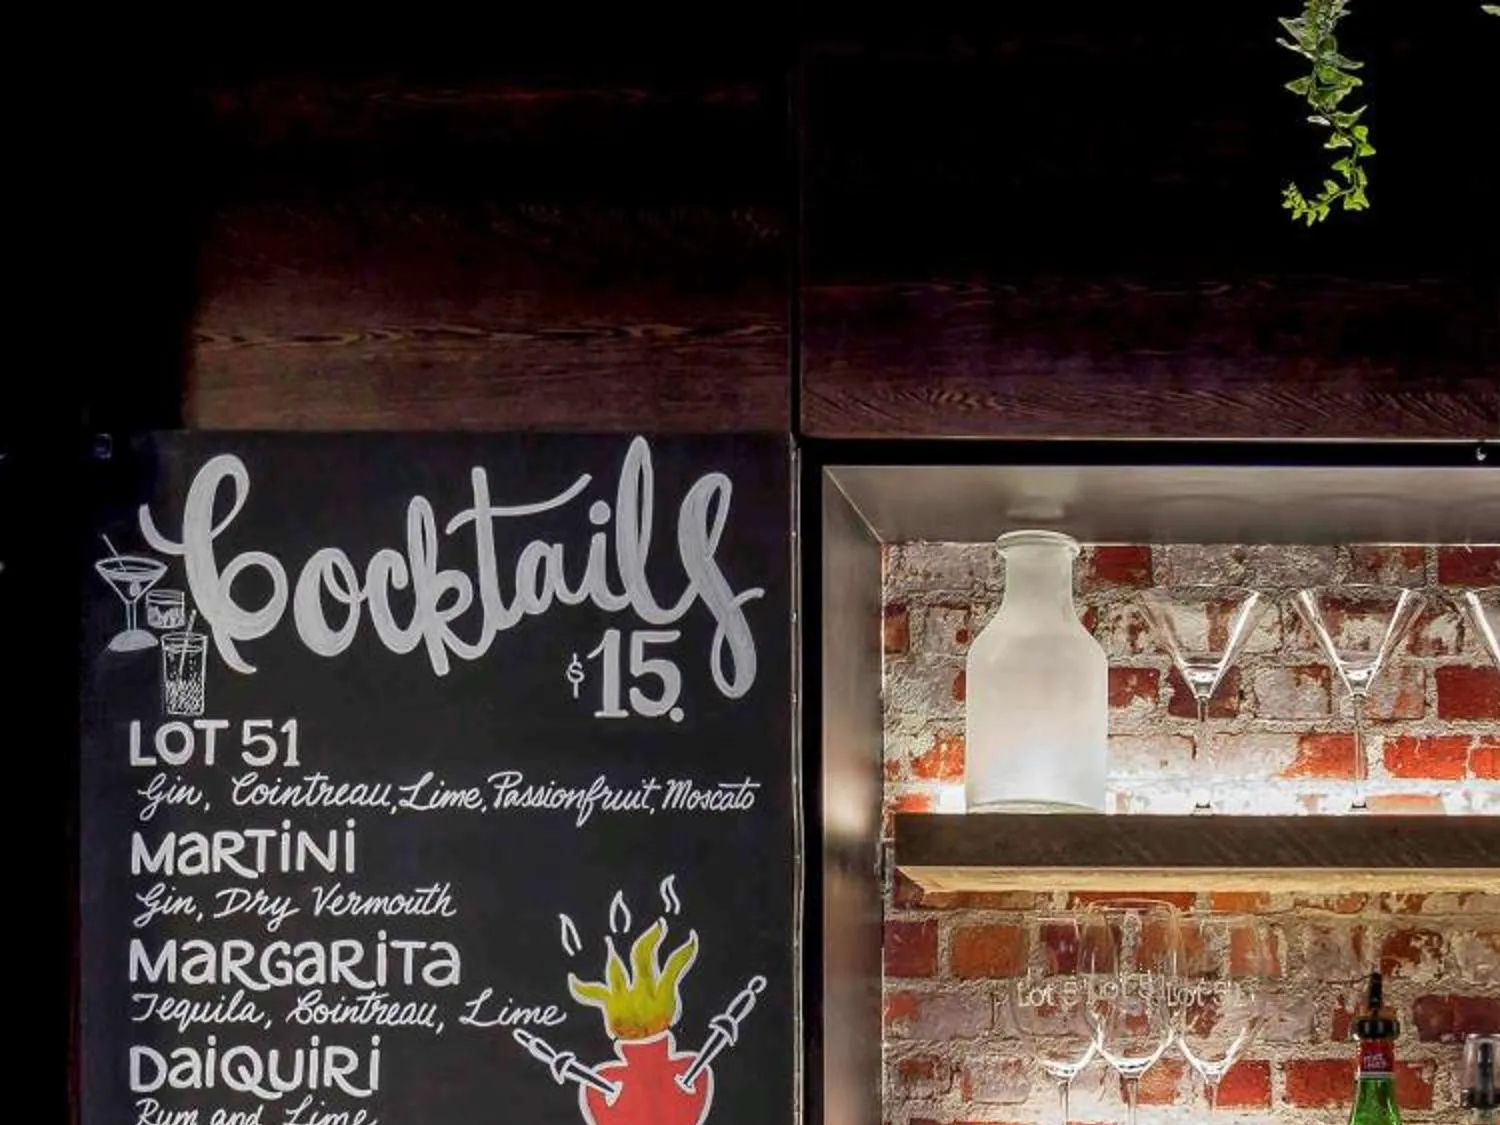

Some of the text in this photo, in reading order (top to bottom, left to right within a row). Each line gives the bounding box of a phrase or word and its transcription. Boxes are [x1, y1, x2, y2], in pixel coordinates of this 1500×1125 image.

[138, 436, 764, 699] Cocktails
[130, 719, 300, 766] LOT 51
[662, 778, 760, 810] Moscato
[214, 888, 300, 932] Dry
[312, 883, 456, 916] Vermouth
[459, 988, 567, 1027] Lime
